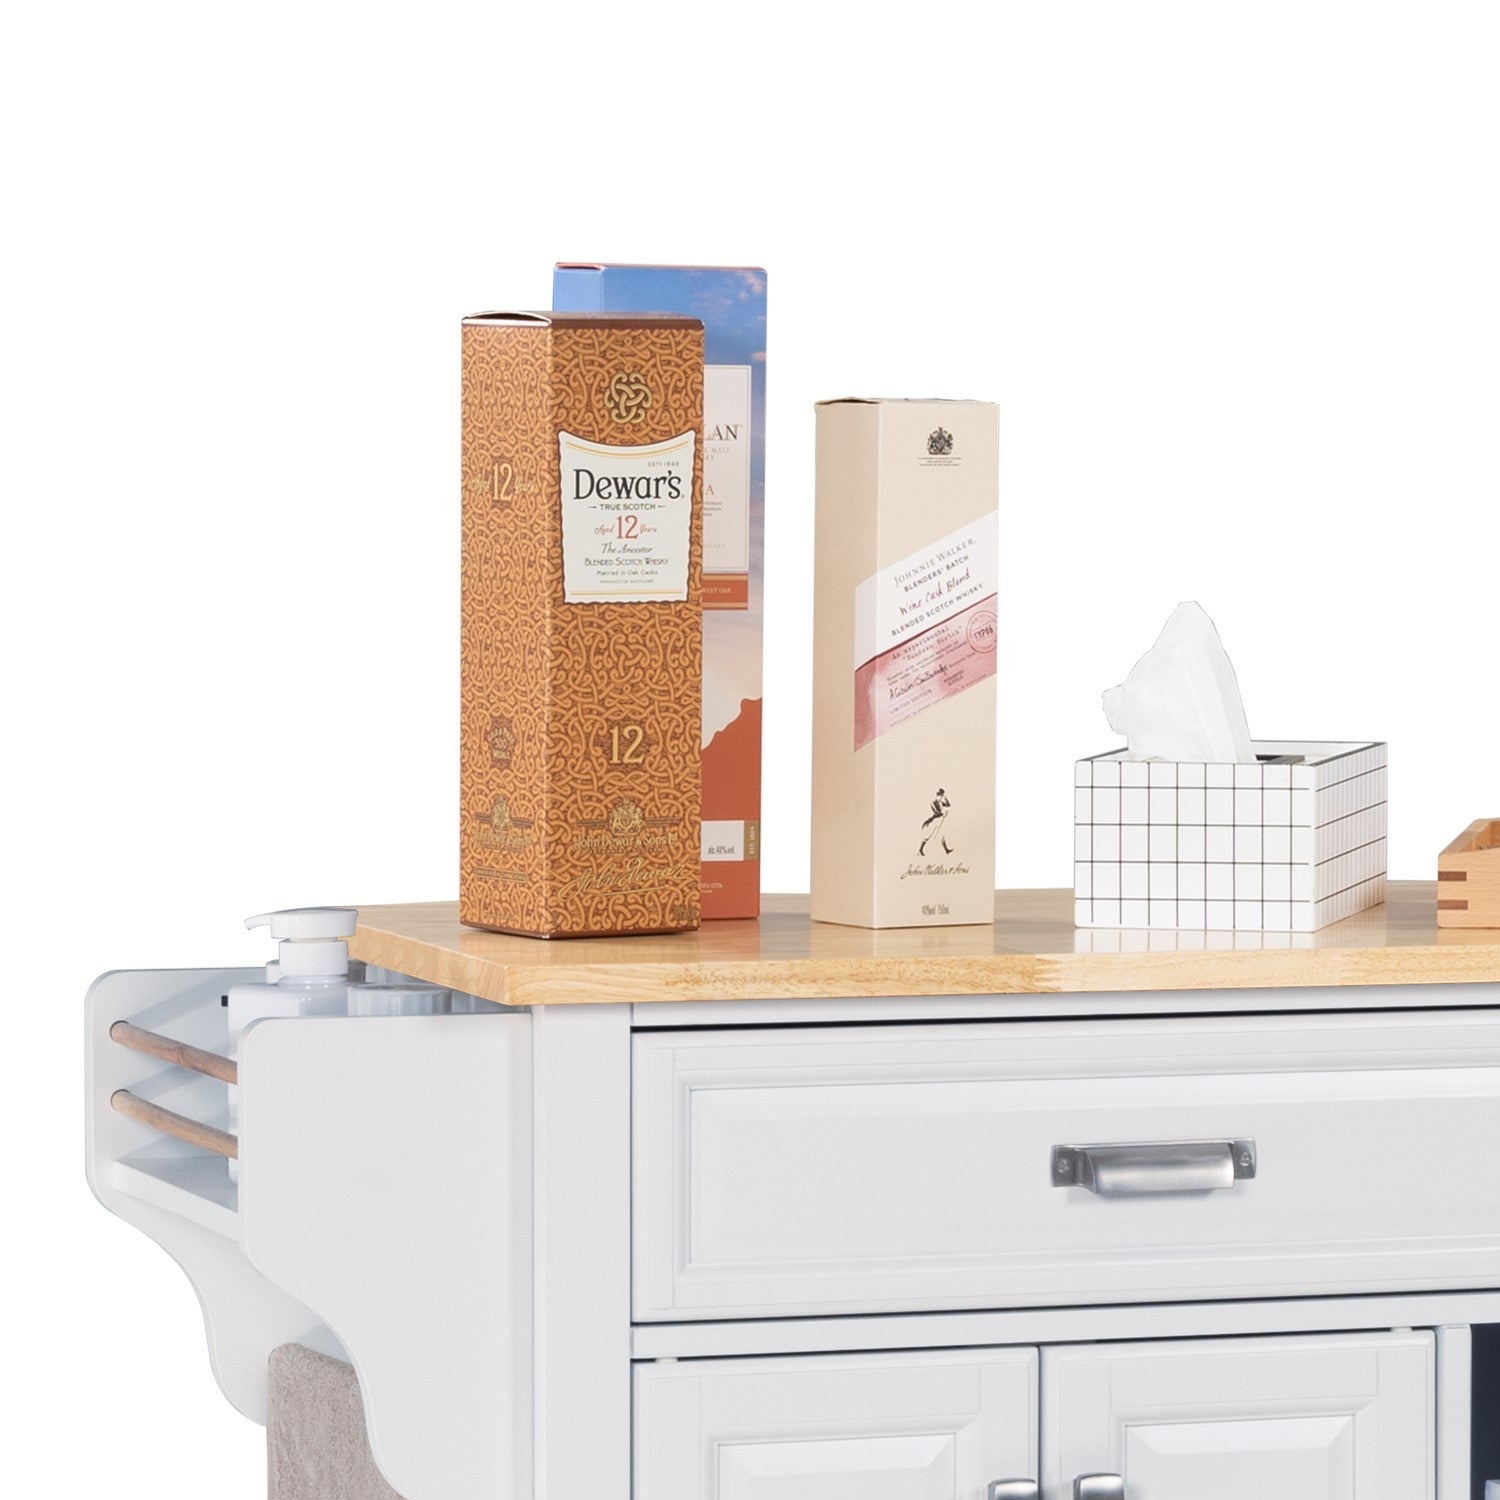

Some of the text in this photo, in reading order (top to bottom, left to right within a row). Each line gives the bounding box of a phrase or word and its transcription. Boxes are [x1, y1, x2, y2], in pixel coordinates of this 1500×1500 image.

[492, 462, 513, 502] 12
[573, 468, 682, 500] Dewar's
[599, 503, 656, 511] TRUE SCOTCH
[594, 524, 614, 536] Aged
[616, 514, 639, 540] 12
[602, 541, 654, 554] The Ancestor
[945, 555, 969, 571] BATCH
[946, 566, 970, 593] Blend
[891, 615, 925, 637] BLENDED
[926, 599, 954, 618] SCOTCH
[955, 583, 984, 602] WHISKY
[608, 725, 645, 764] 12
